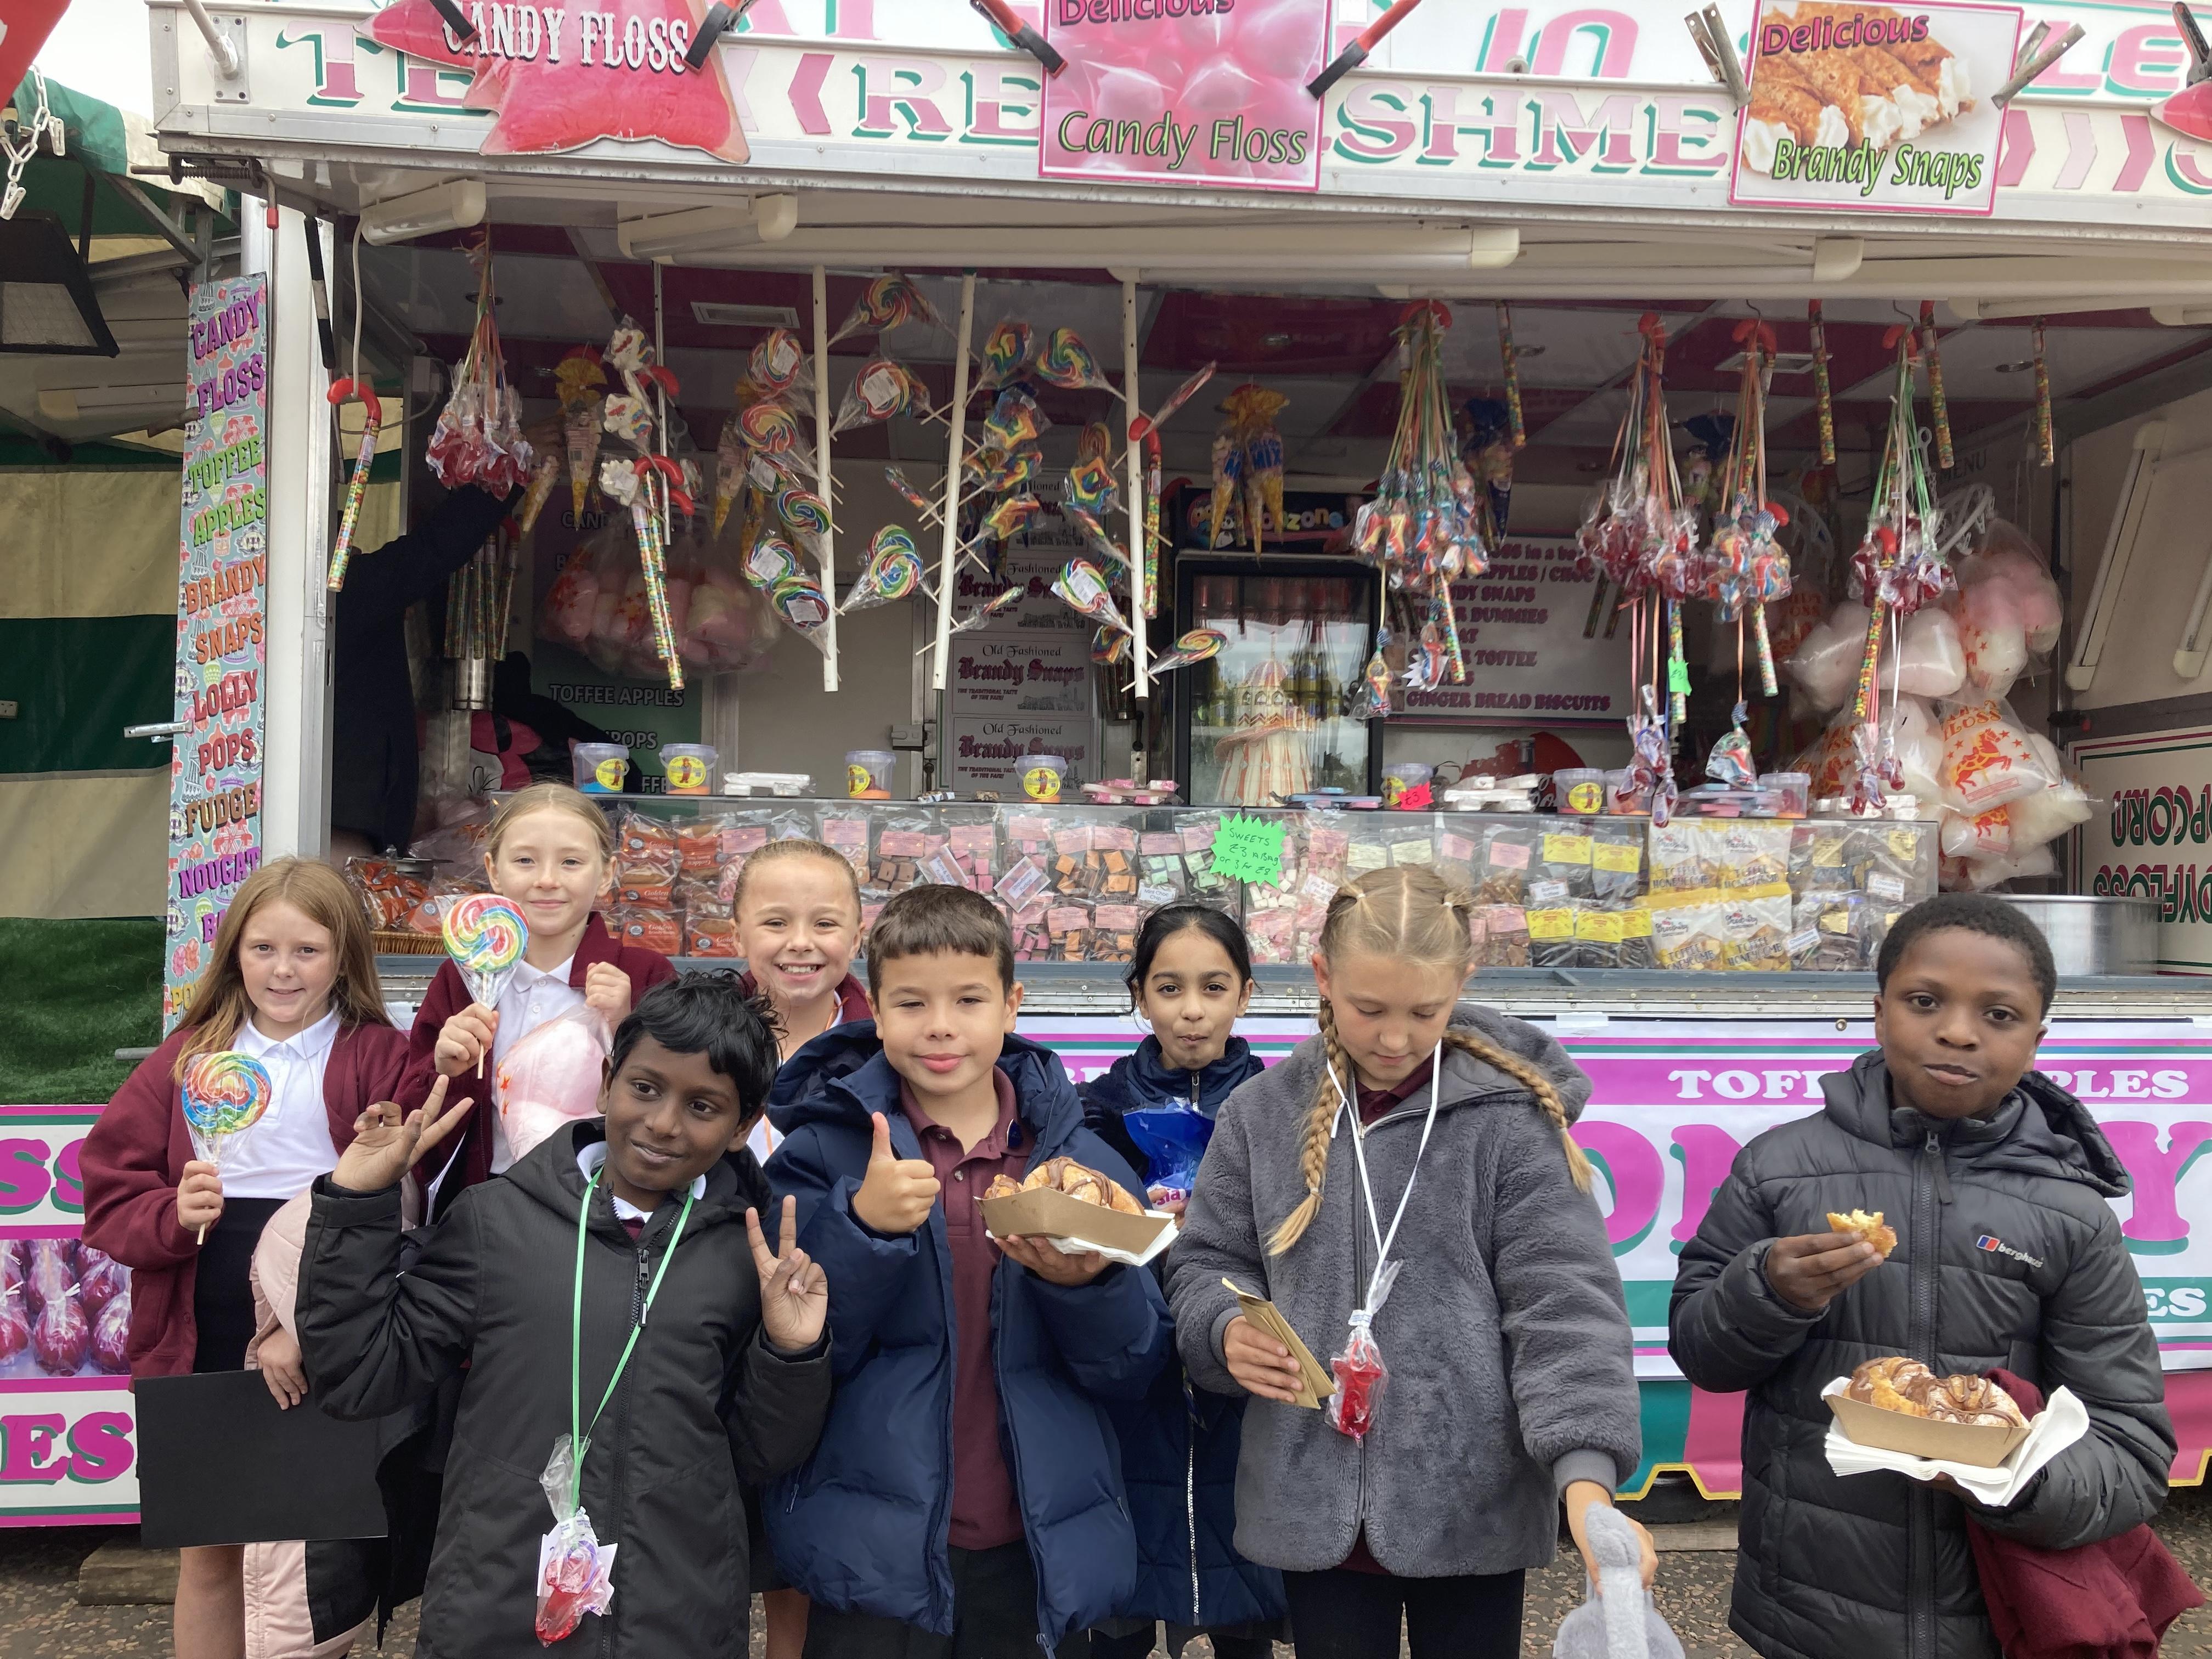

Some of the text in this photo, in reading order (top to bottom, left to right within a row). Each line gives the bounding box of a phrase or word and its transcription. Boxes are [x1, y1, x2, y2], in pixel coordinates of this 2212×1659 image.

[581, 17, 688, 74] FLOSS
[1762, 14, 1929, 56] Delicious
[1058, 111, 1307, 170] Candy Floss
[1772, 138, 1984, 200] Brandy Snaps
[193, 291, 261, 361] CANDY
[198, 353, 265, 419] FLOSS
[188, 435, 262, 494] TOFFEE
[194, 488, 266, 548] APPLES
[185, 554, 266, 615] BRANDY
[1481, 585, 1536, 602] SNAPS
[1471, 606, 1548, 624] DUMMIES
[195, 612, 264, 665] SNAPS
[982, 645, 1061, 658] Old Fashioned
[958, 657, 1085, 686] Brandy Snaps
[1475, 651, 1538, 667] TOFFEE
[193, 669, 258, 723] LOLLY
[550, 684, 684, 707] TOFFEE APPLES
[1407, 690, 1611, 712] GINGER BREAD BISCUITS
[983, 723, 1062, 737] Old Fashioned
[198, 729, 256, 777] POPS
[958, 735, 1025, 763] Brandy
[184, 782, 258, 838] FUDGE
[1404, 793, 1420, 805] £3
[1229, 828, 1269, 846] SWEETS
[1229, 844, 1247, 857] £3
[179, 847, 262, 899] NOUGAT
[1234, 860, 1239, 870] 3
[1255, 867, 1271, 875] £8
[1666, 950, 1714, 970] ONEYCOMB
[1997, 1243, 2043, 1268] berghaus
